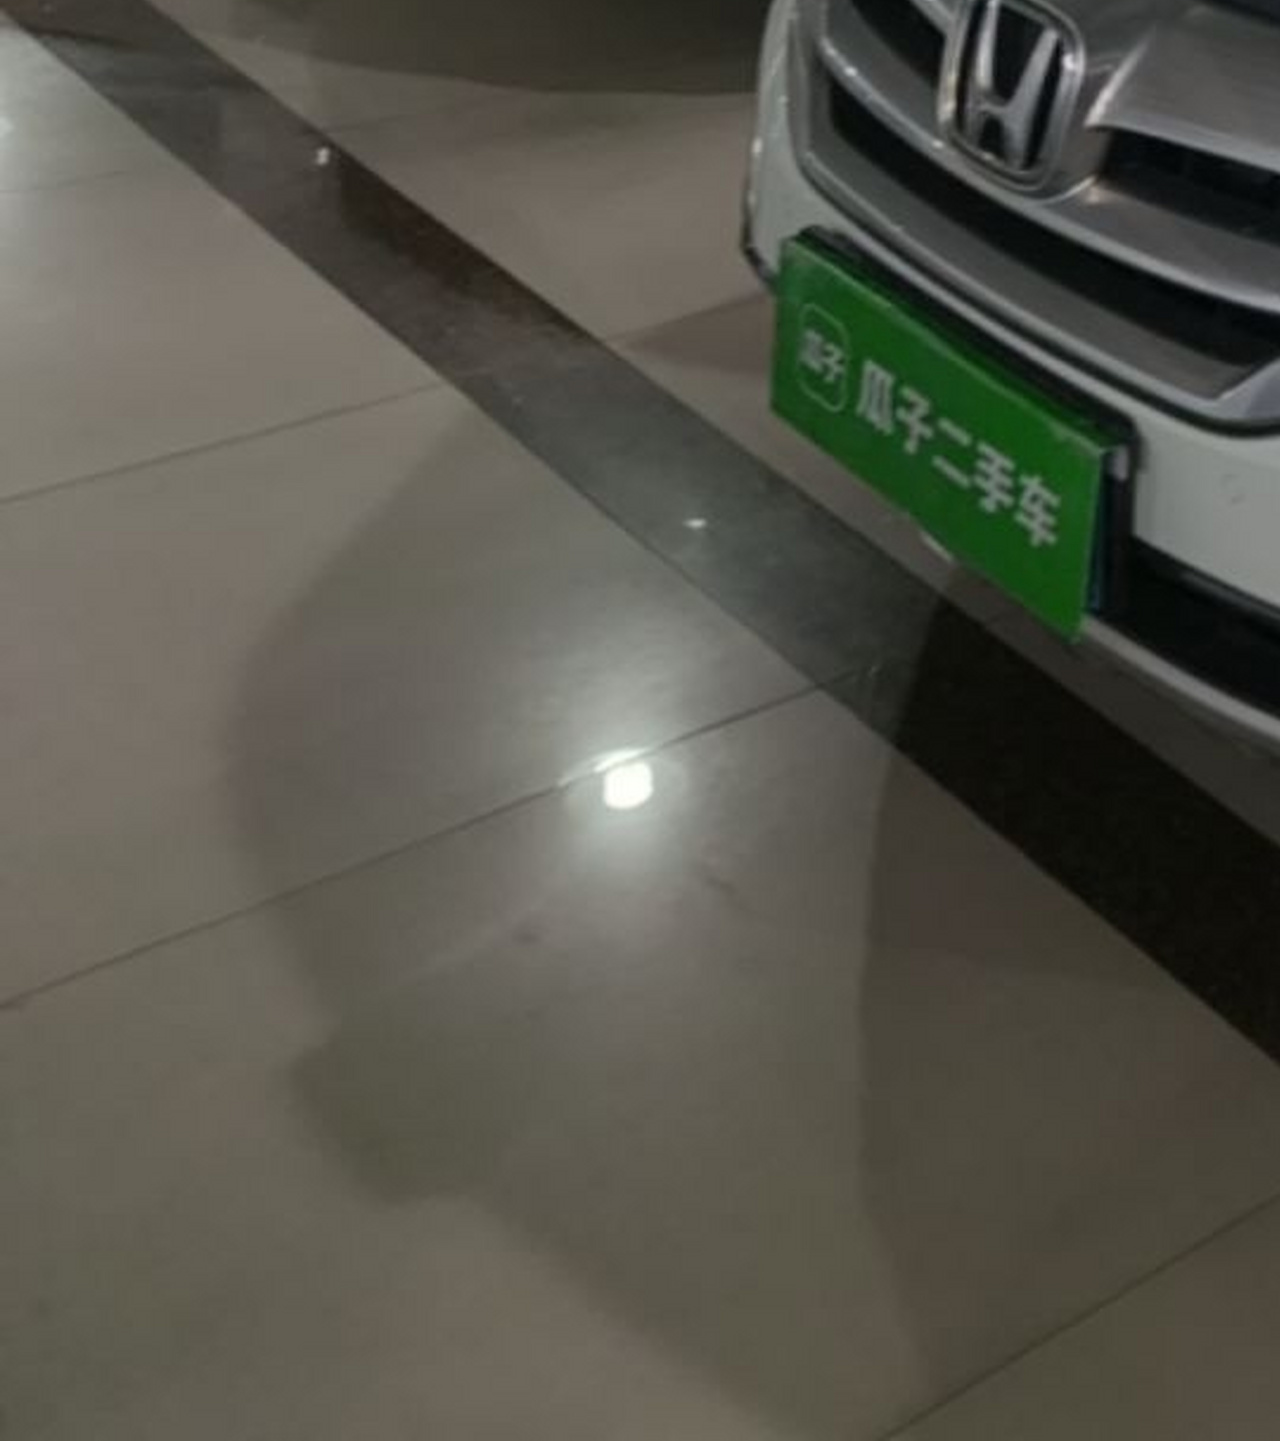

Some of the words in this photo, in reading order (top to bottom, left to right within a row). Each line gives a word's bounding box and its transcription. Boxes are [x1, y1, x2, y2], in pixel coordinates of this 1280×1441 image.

[855, 358, 1062, 547] 瓜子二手车
